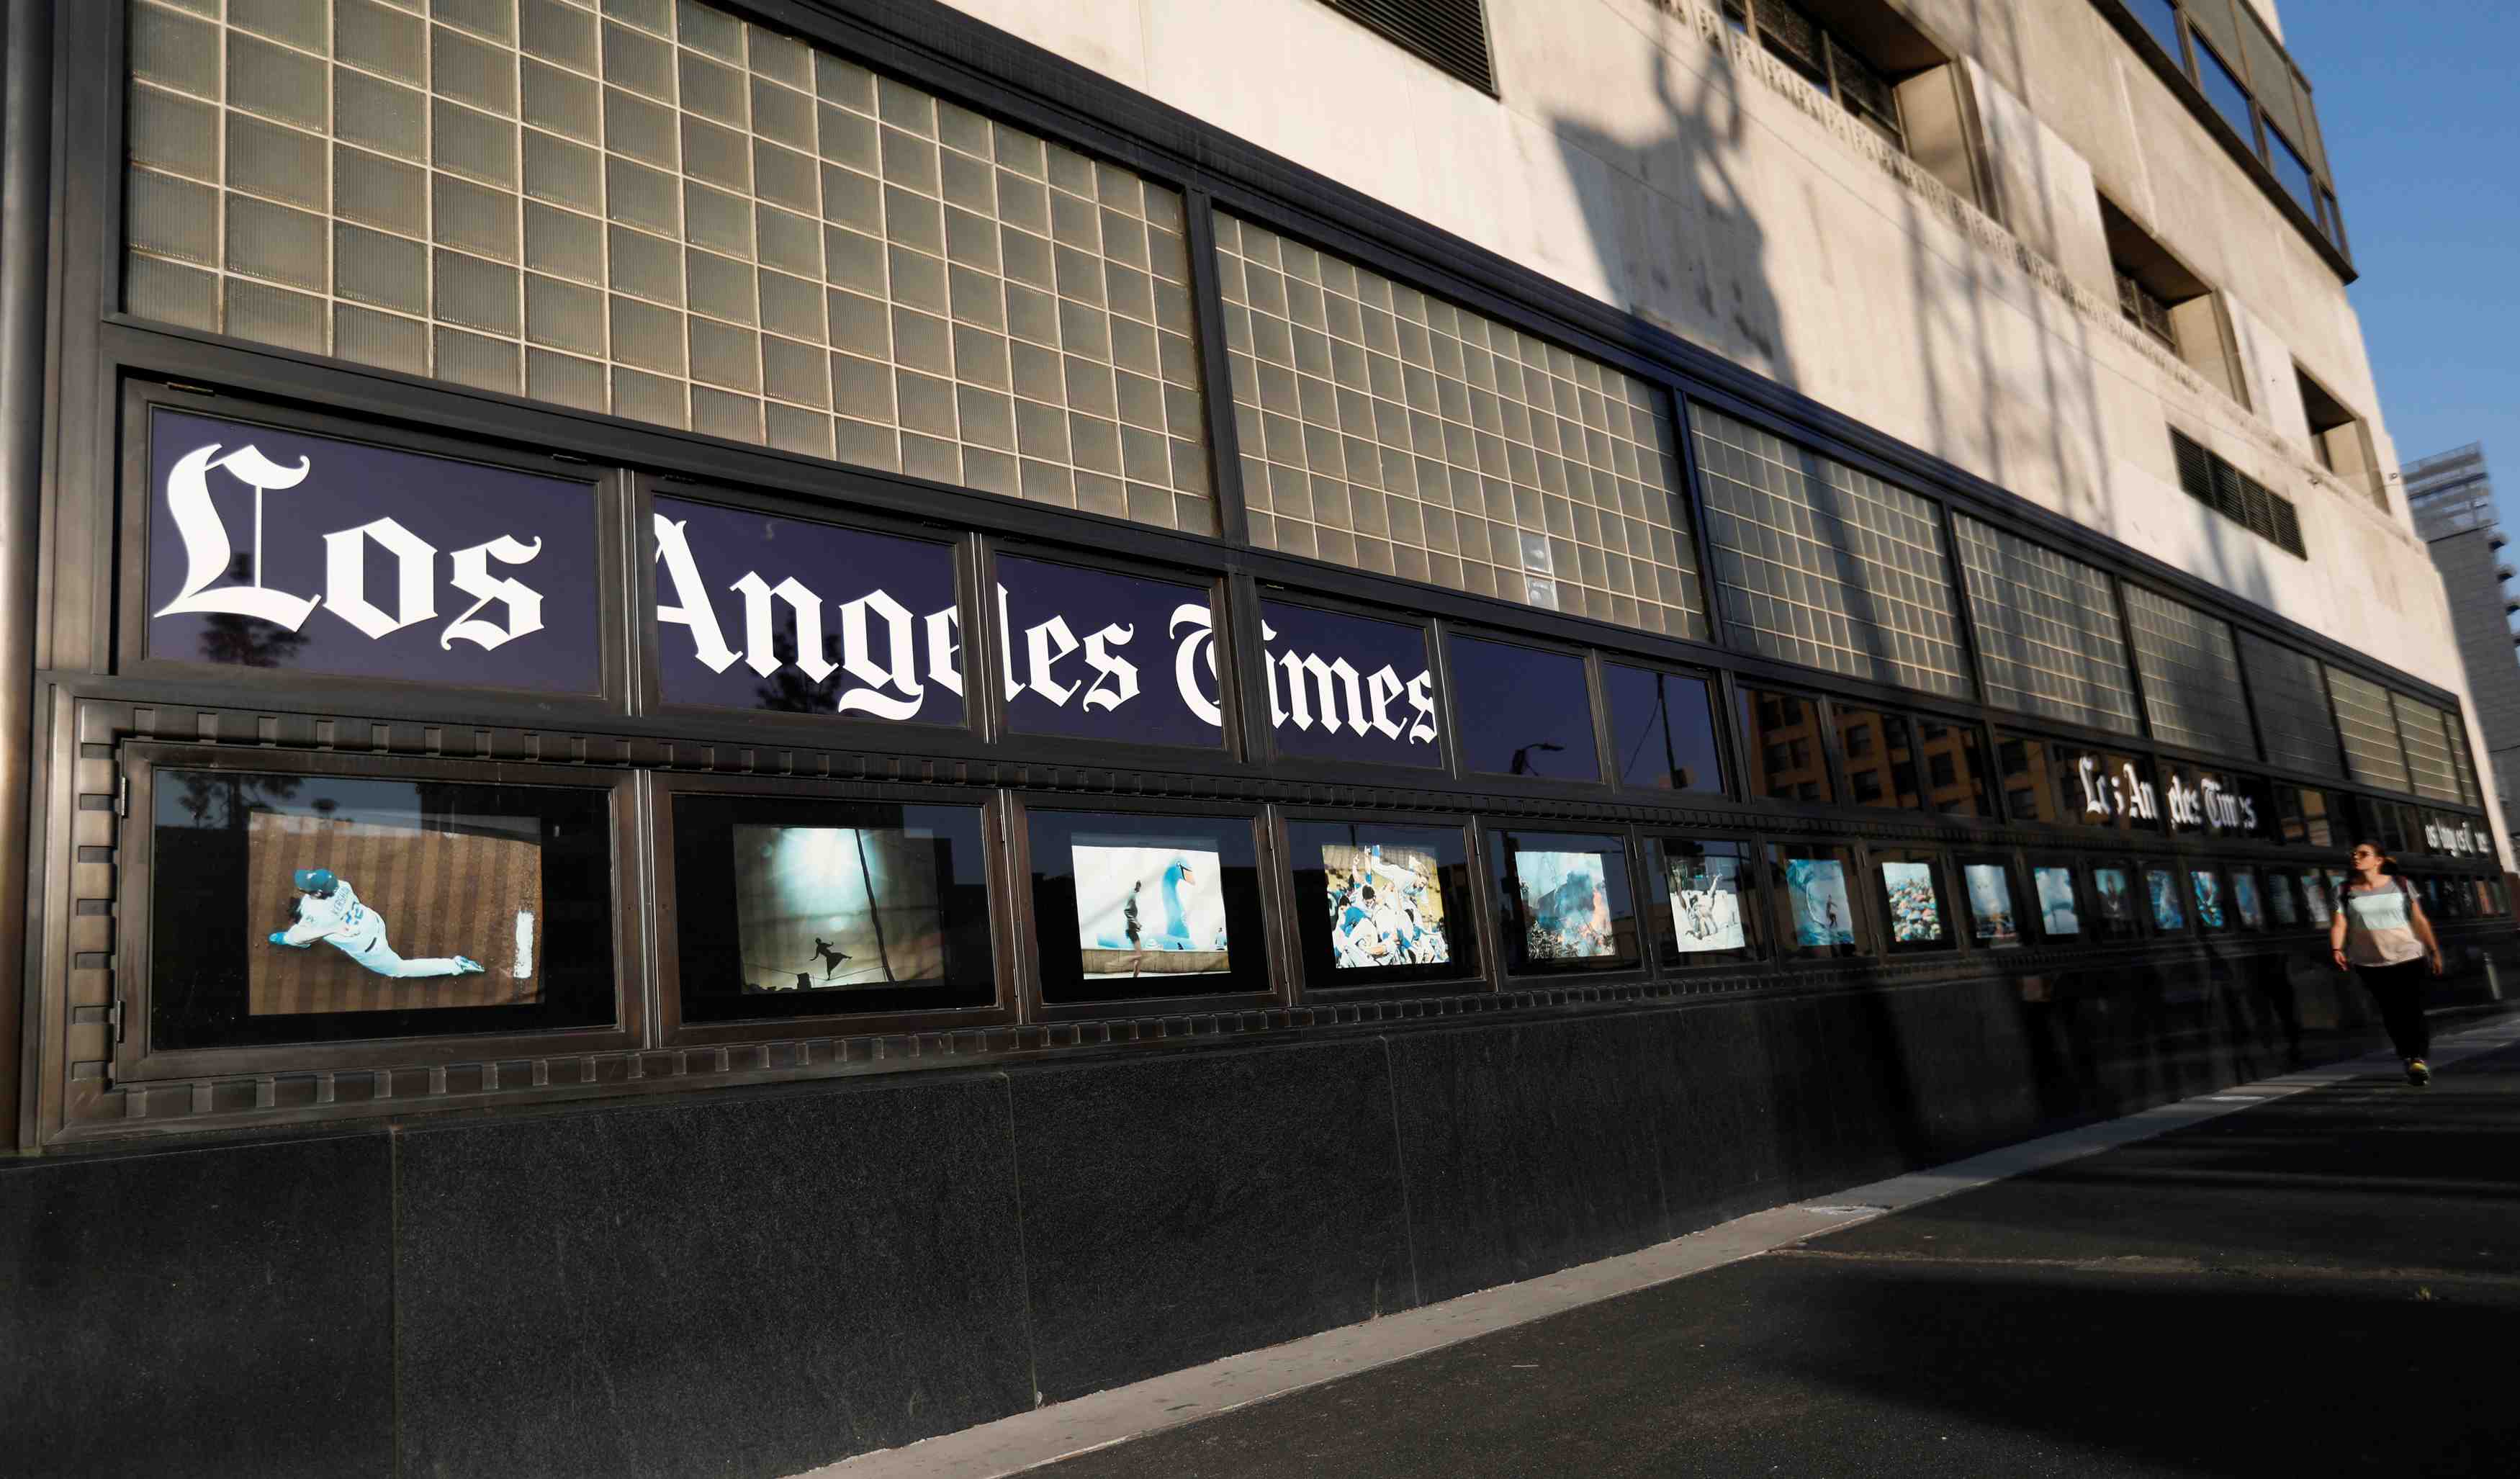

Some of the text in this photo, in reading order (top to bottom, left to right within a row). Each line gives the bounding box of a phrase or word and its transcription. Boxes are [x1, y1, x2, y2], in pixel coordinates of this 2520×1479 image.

[155, 443, 545, 652] Los
[654, 513, 1141, 721] Angeles
[2123, 762, 2202, 830] Aneles
[2200, 777, 2258, 830] Tims
